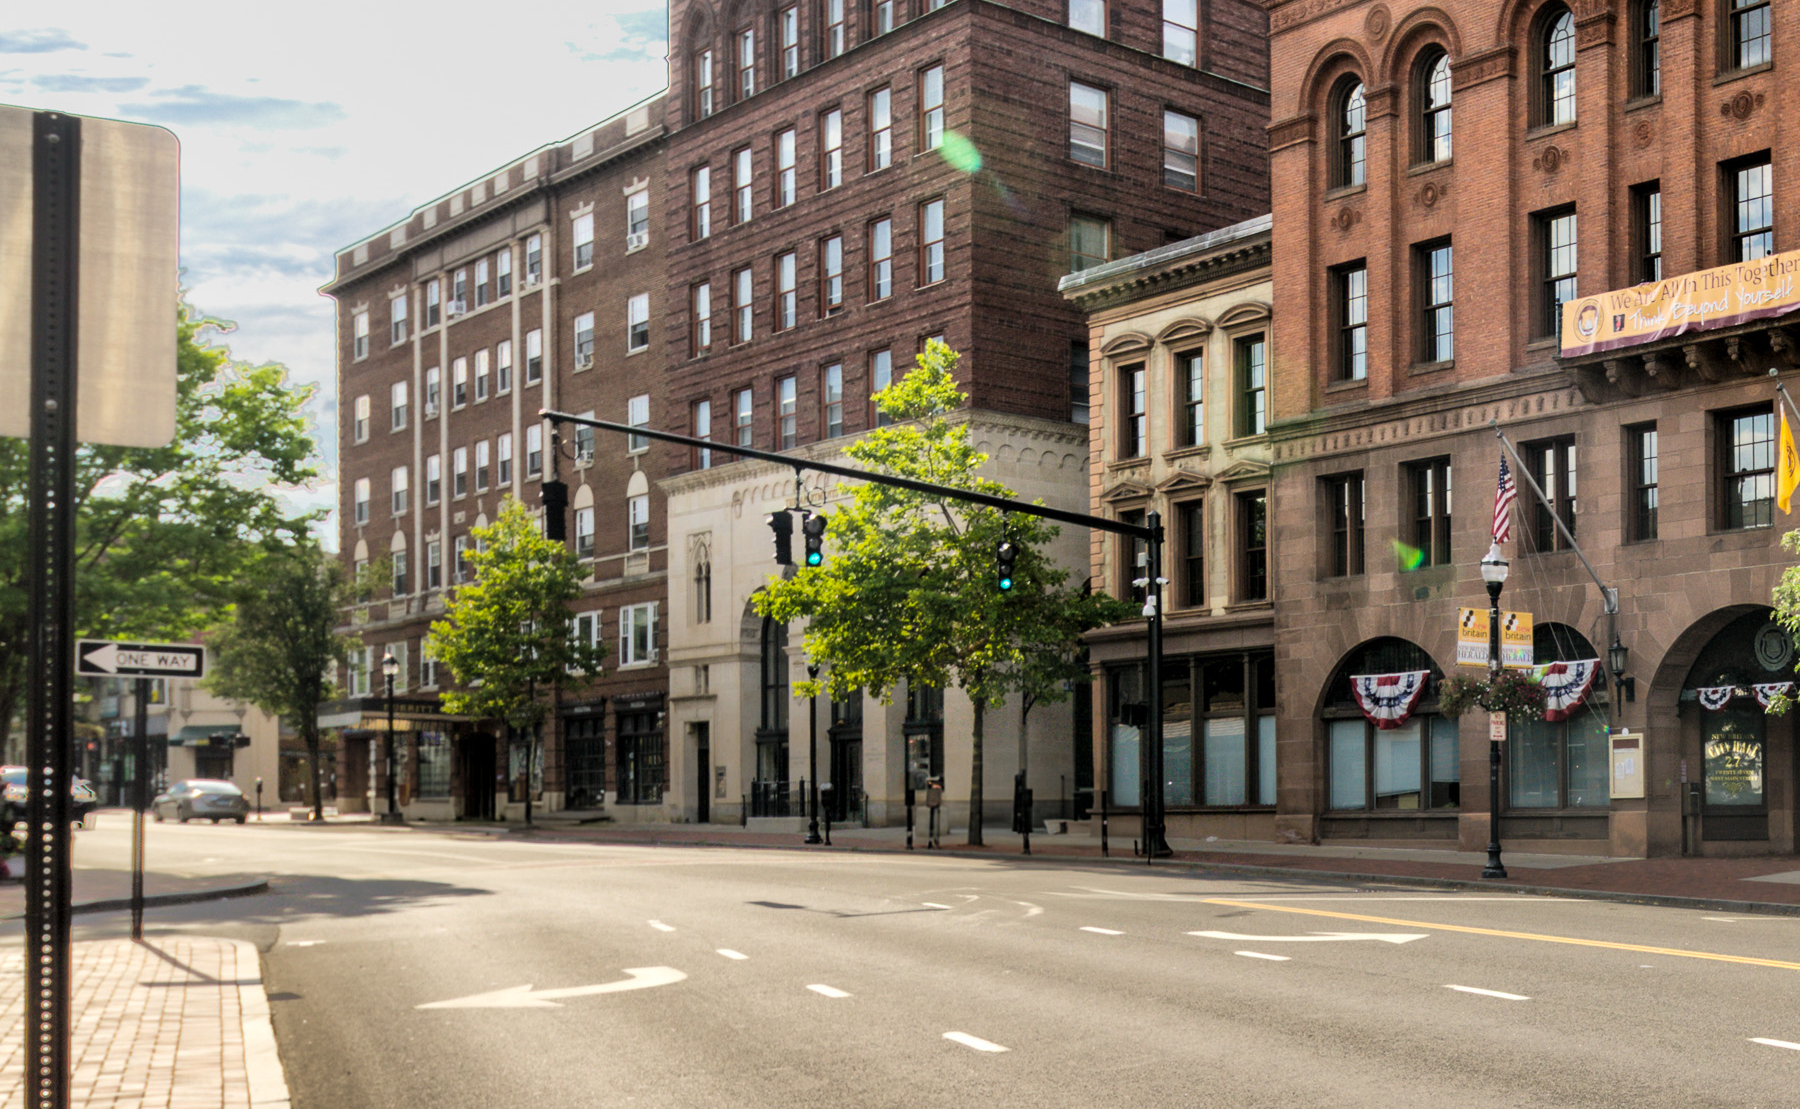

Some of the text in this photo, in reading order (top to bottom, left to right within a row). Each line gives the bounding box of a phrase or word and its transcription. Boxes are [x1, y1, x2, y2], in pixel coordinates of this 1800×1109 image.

[1611, 293, 1631, 310] We
[1634, 291, 1655, 307] Are
[1661, 280, 1679, 301] All
[1683, 278, 1697, 294] In
[1701, 270, 1732, 291] This
[1736, 258, 1800, 285] Together
[1629, 307, 1665, 331] Think
[1672, 290, 1729, 326] Beyond
[1735, 276, 1794, 311] Yourself
[1462, 628, 1488, 638] britain
[1505, 631, 1532, 641] britain
[116, 652, 191, 668] ONE WAY
[1458, 650, 1488, 660] HERALD
[1502, 653, 1533, 662] HERALD
[1725, 756, 1740, 768] 27
